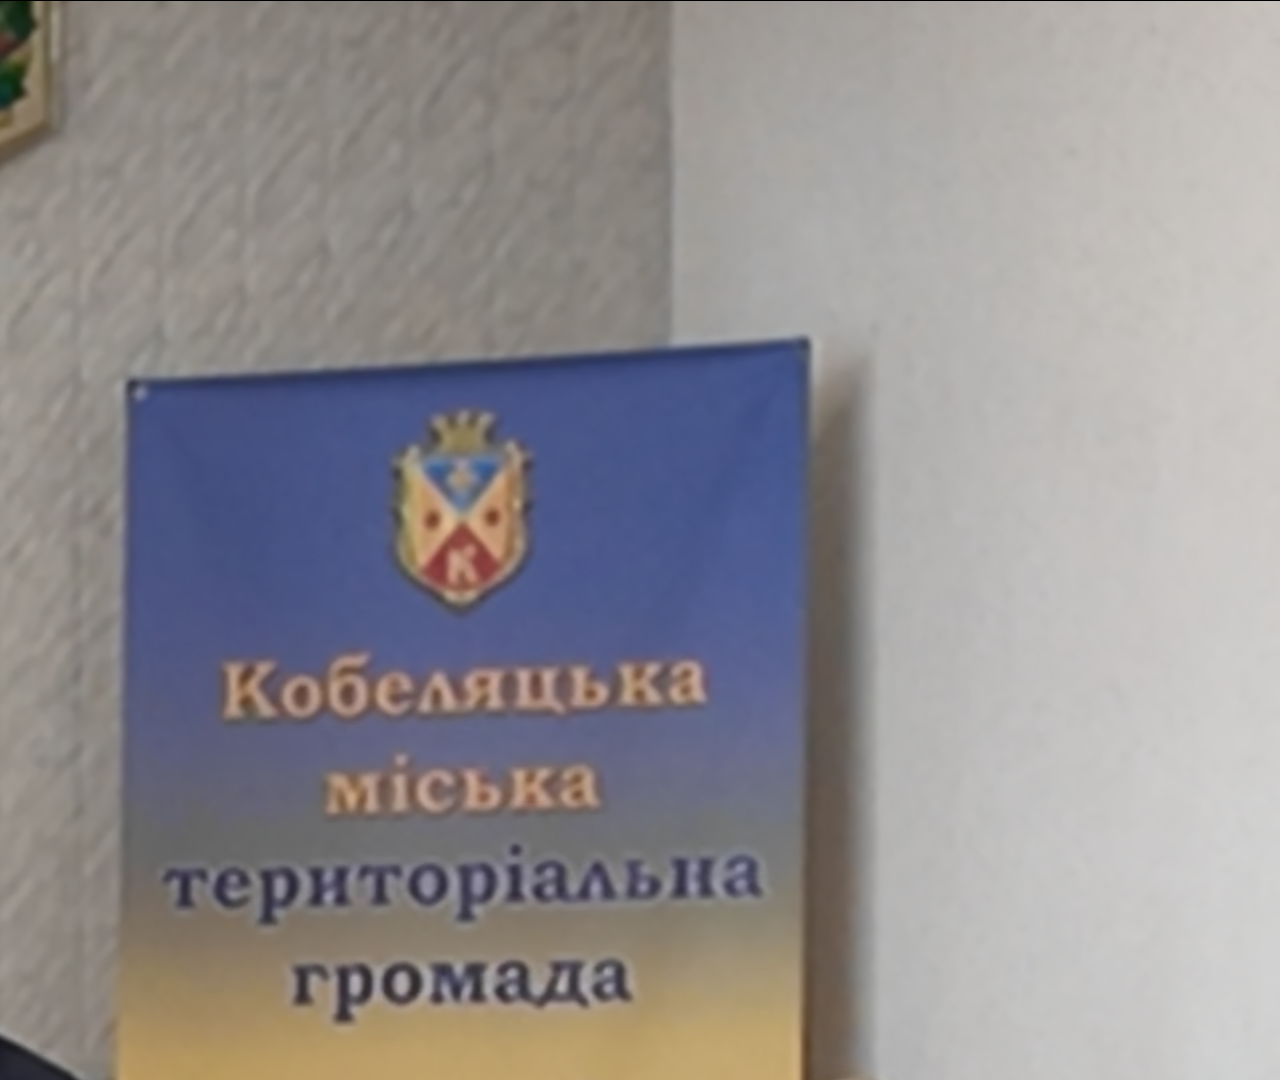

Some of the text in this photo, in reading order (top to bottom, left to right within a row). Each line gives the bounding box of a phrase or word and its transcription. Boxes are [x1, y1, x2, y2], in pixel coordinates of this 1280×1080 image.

[222, 654, 708, 719] Кобеляцька
[324, 755, 601, 815] міська
[164, 846, 763, 924] територіальна
[291, 956, 632, 1021] громада
